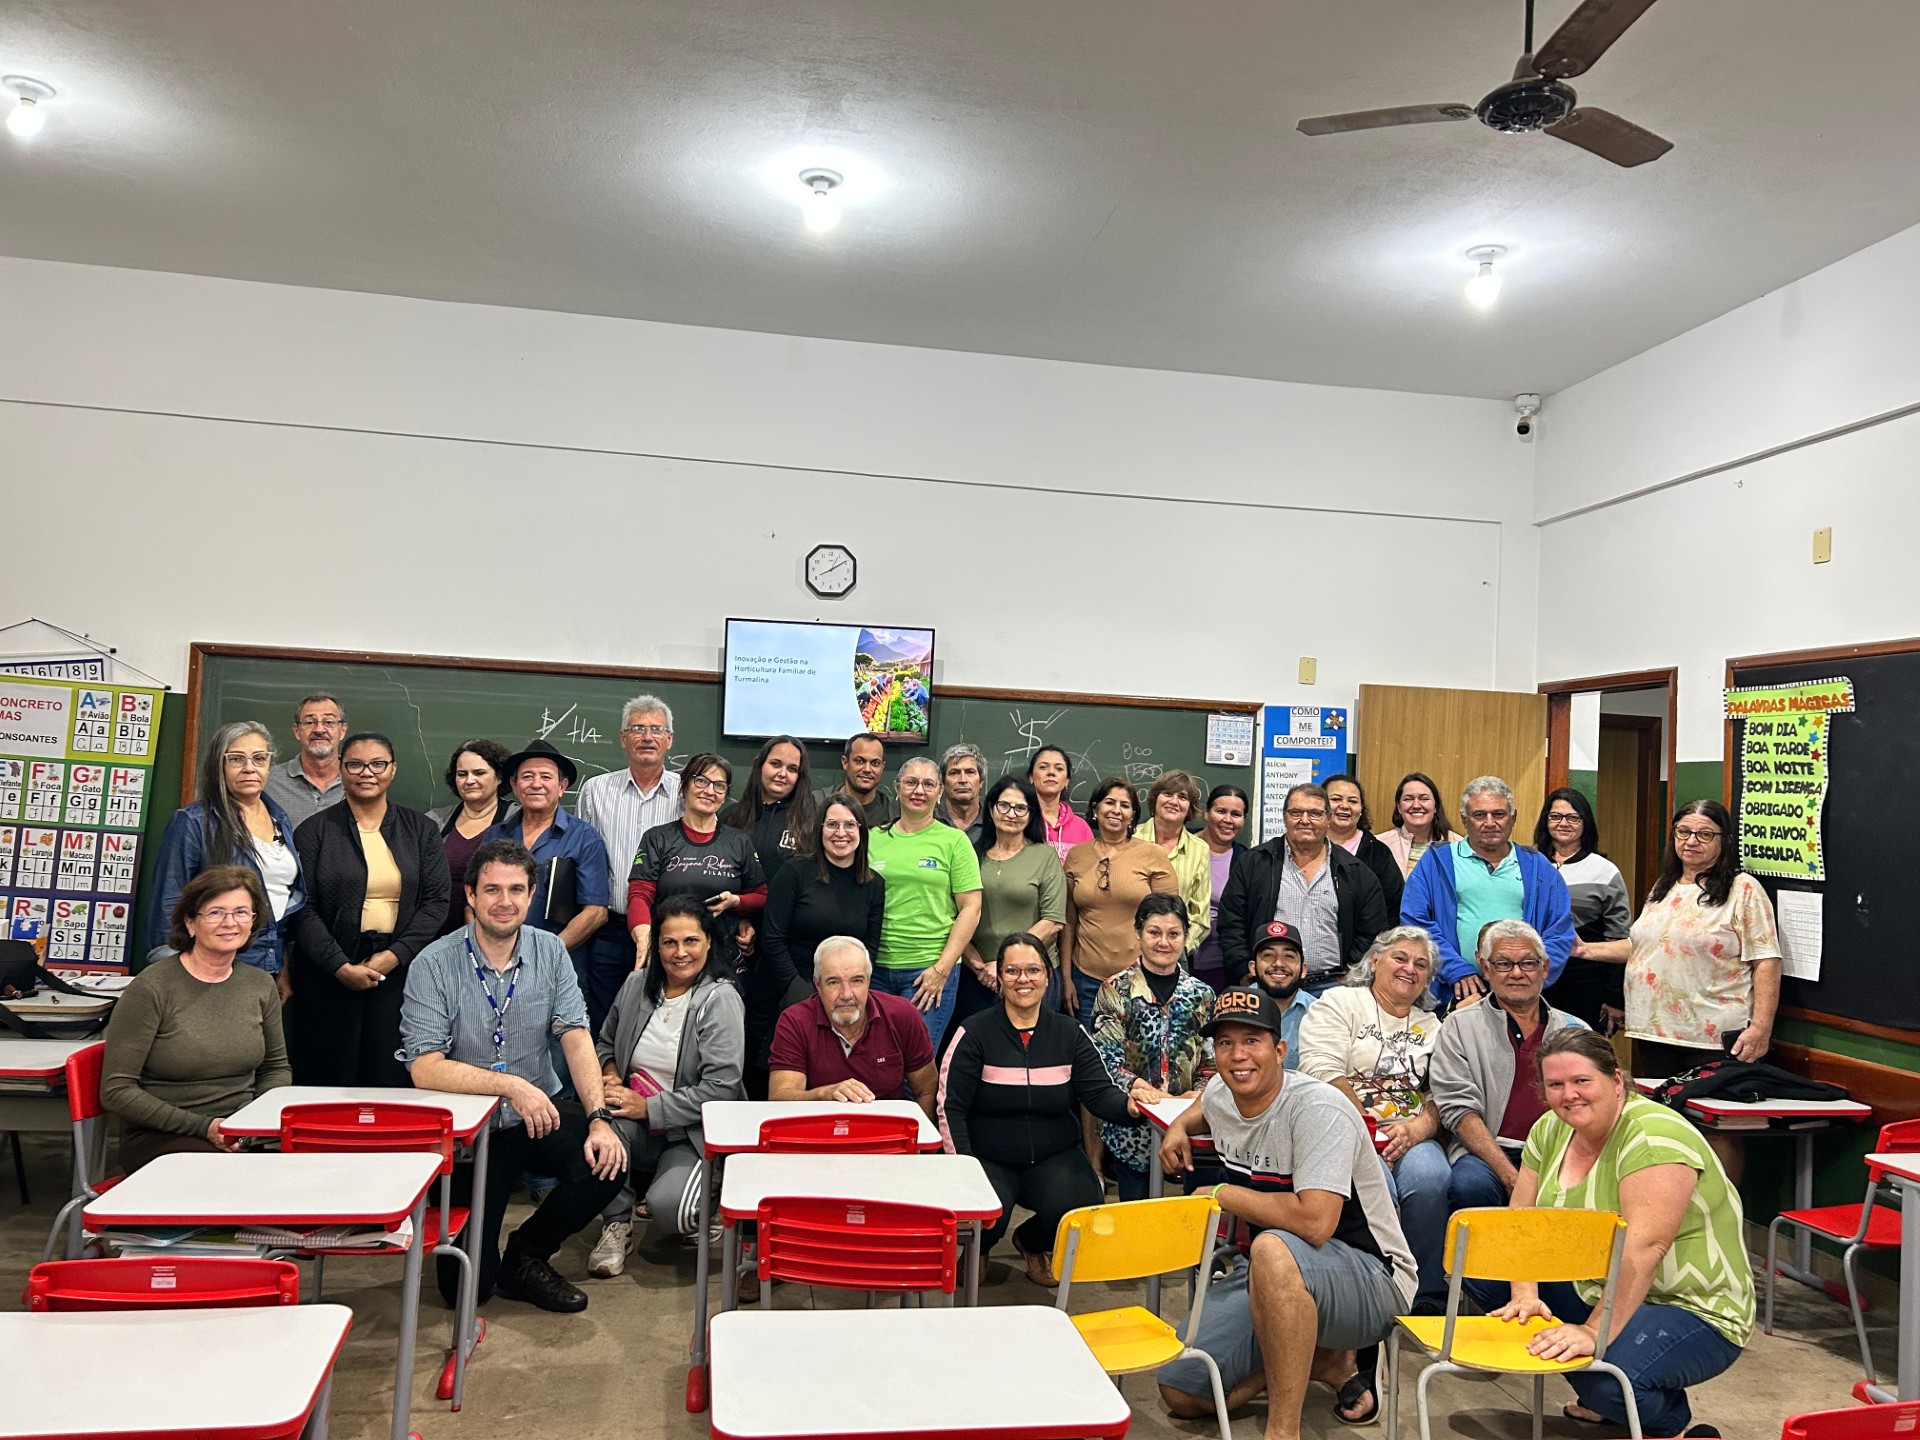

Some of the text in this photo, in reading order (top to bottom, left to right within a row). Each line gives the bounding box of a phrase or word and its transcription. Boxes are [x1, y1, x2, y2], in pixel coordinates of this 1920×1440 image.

[735, 655, 766, 664] Inovação
[774, 656, 798, 665] Gestão
[38, 667, 46, 676] 6
[55, 666, 62, 676] 7
[72, 665, 80, 676] 8
[89, 664, 97, 675] 9
[735, 666, 776, 674] Horticultura
[0, 697, 62, 710] ONCRETO
[80, 692, 96, 709] A
[121, 695, 136, 712] B
[1727, 691, 1850, 715] PALAVRAS MÁGICAS
[130, 714, 149, 722] Bola
[1292, 707, 1320, 716] COMO
[78, 723, 104, 734] A a
[120, 725, 145, 738] B b
[1749, 722, 1797, 737] BOM DIA
[0, 732, 57, 744] ONSOANTES
[1276, 736, 1334, 745] COMPORTEI?
[1746, 741, 1810, 756] BOA TARDE
[32, 763, 46, 779] F
[73, 766, 90, 784] G
[1746, 761, 1814, 776] BOA NOITE
[112, 769, 128, 786] H
[40, 782, 61, 790] Foca
[82, 785, 101, 793] Gato
[1746, 780, 1822, 798] COM LICENÇA
[8, 793, 16, 801] e
[31, 792, 40, 803] F
[70, 796, 97, 810] G g
[111, 798, 136, 810] H h
[1745, 802, 1803, 818] OBRIGADO
[25, 830, 37, 846] L
[1743, 824, 1807, 841] POR FAVOR
[65, 833, 83, 849] M
[106, 836, 120, 852] N
[32, 849, 52, 858] Laranja
[69, 851, 93, 860] Macaco
[1743, 843, 1803, 863] DESCULPA
[23, 860, 31, 871] L
[61, 862, 91, 874] M m
[103, 865, 129, 876] N n
[15, 900, 31, 916] R
[56, 902, 71, 918] S
[98, 904, 111, 920] T
[64, 920, 85, 930] Sapo
[104, 922, 125, 930] Tomate
[55, 931, 81, 942] S s
[96, 933, 120, 945] T t
[1214, 992, 1260, 1012] AGRO
